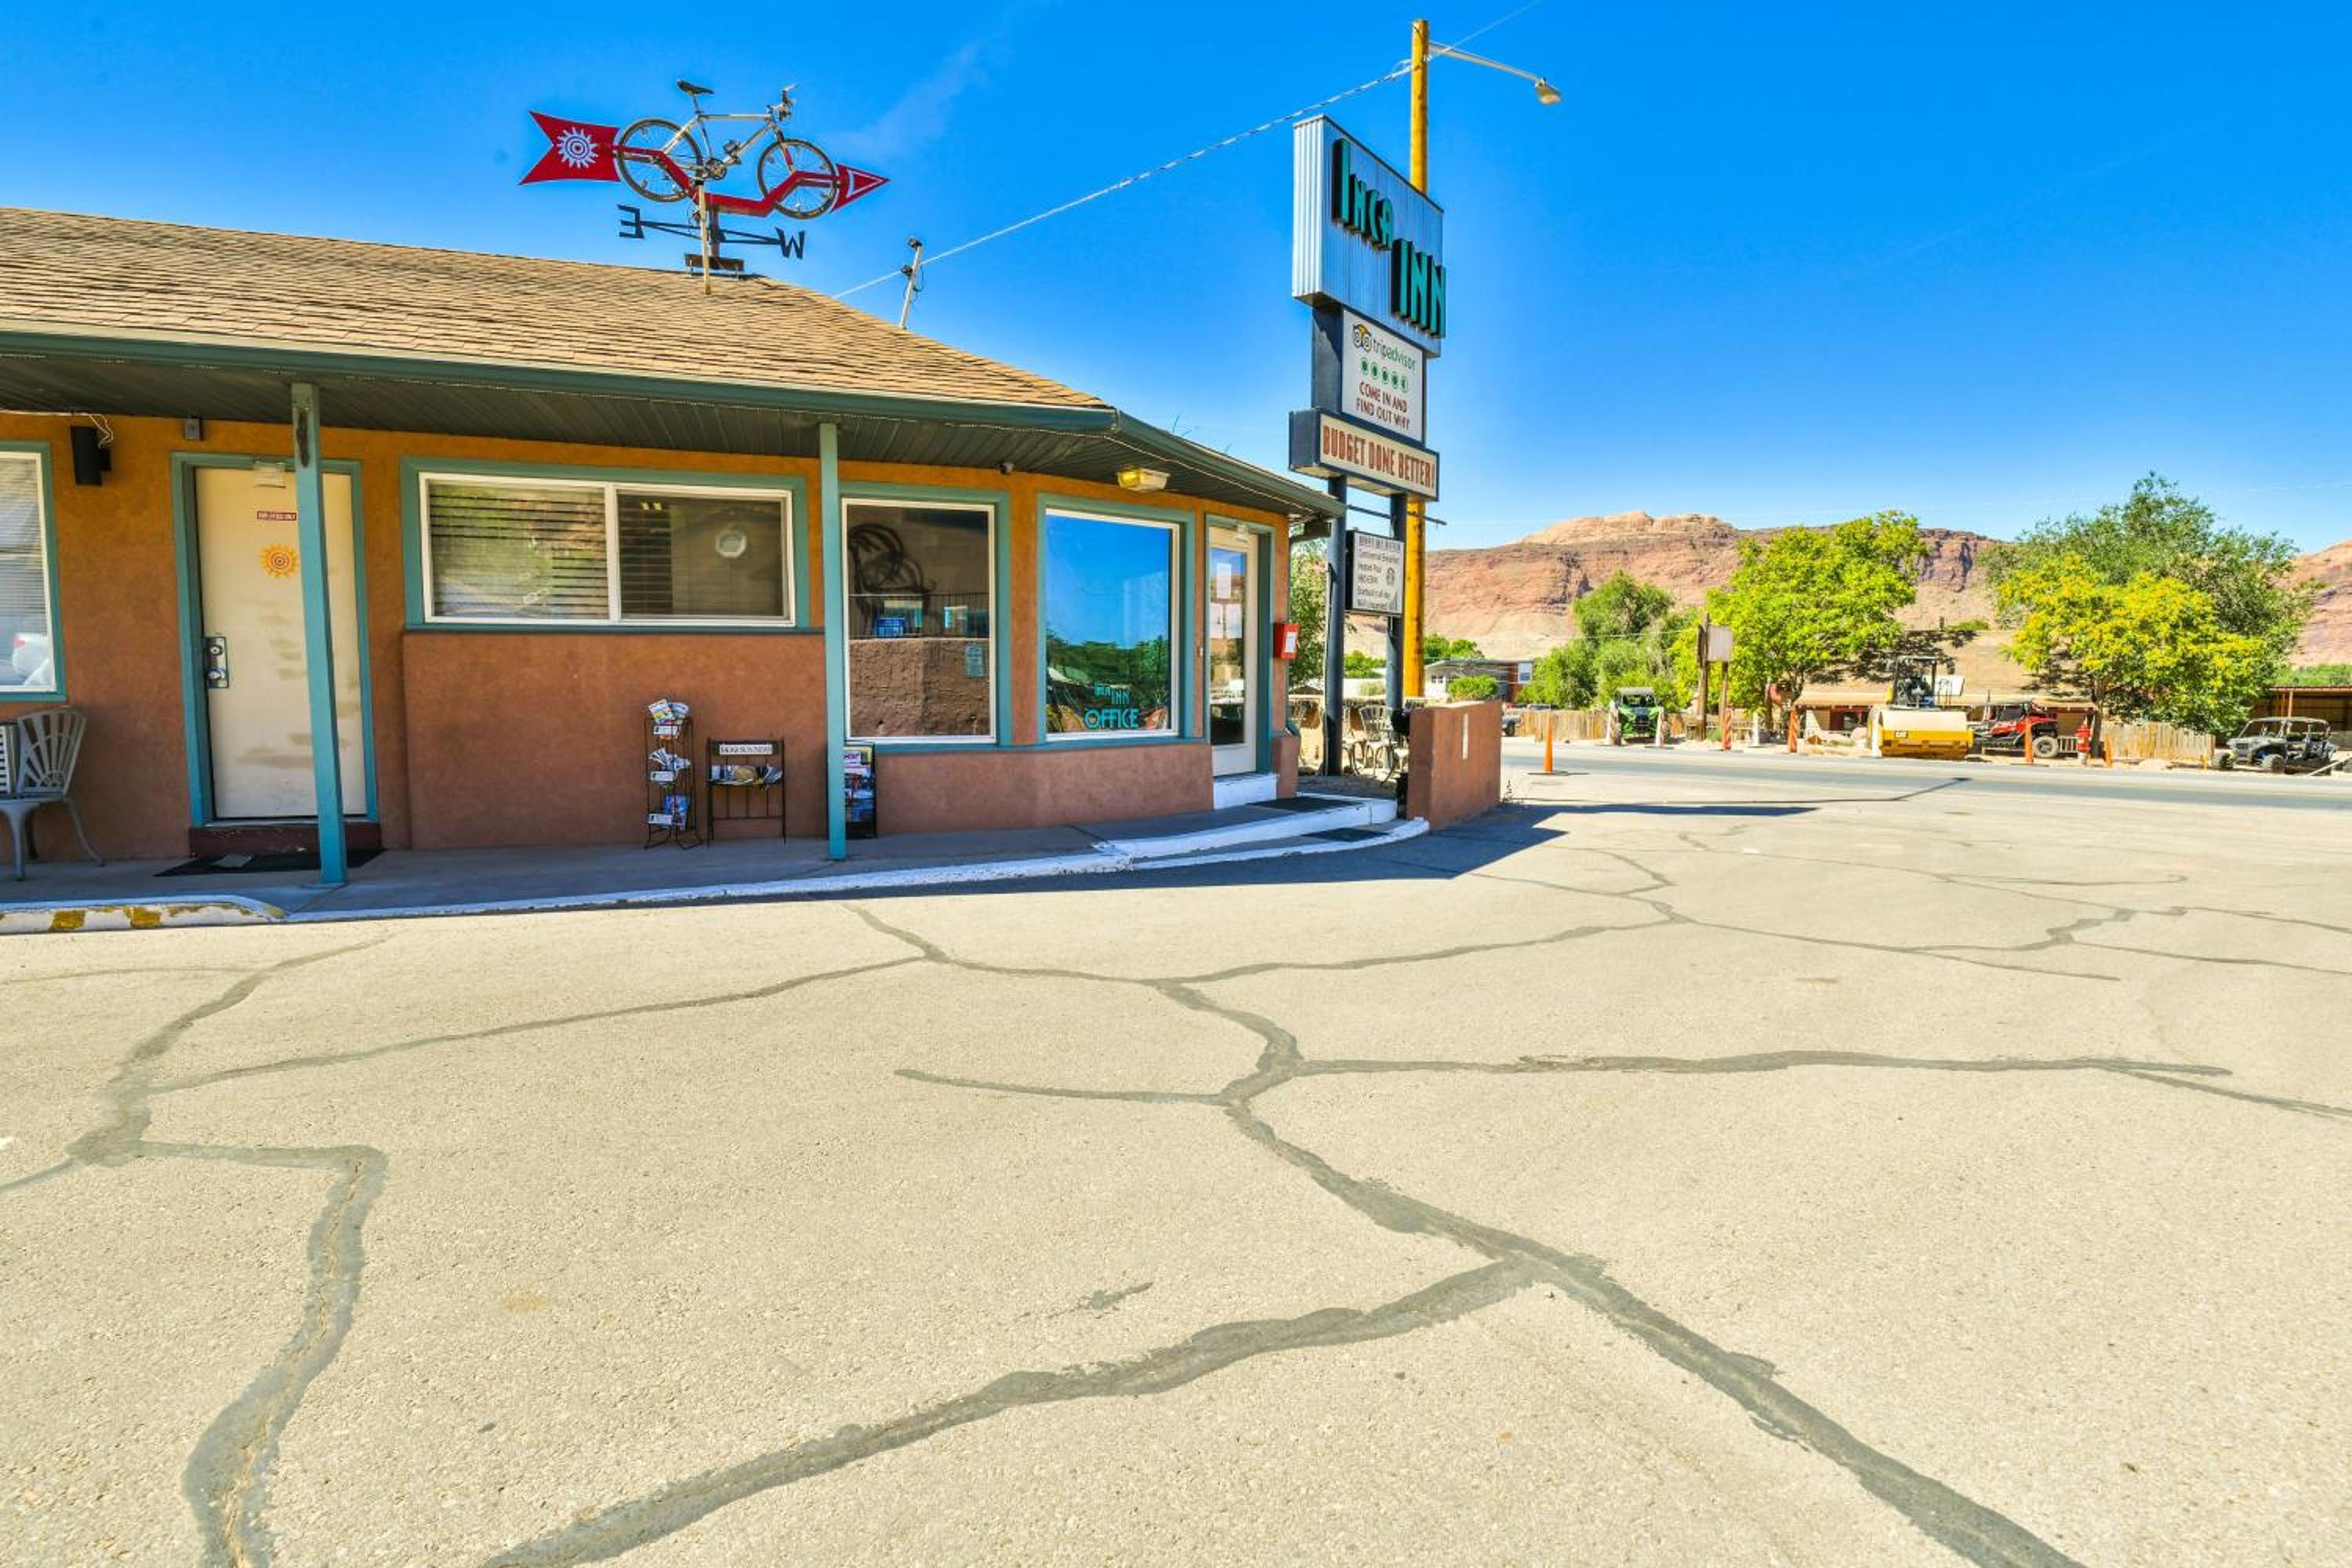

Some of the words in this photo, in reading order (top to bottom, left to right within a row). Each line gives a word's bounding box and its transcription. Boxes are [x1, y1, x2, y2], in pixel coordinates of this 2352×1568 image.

[775, 227, 805, 260] W
[1391, 238, 1446, 339] INN
[1373, 339, 1417, 371] tripadvisor
[1356, 398, 1374, 416] FIND
[1376, 406, 1392, 423] OUT
[1359, 382, 1381, 402] COME
[1382, 391, 1392, 405] IN
[1392, 397, 1407, 413] AND
[1323, 426, 1367, 466] BUDGET
[1368, 441, 1396, 476] DONE
[1084, 708, 1139, 728] OFFICE
